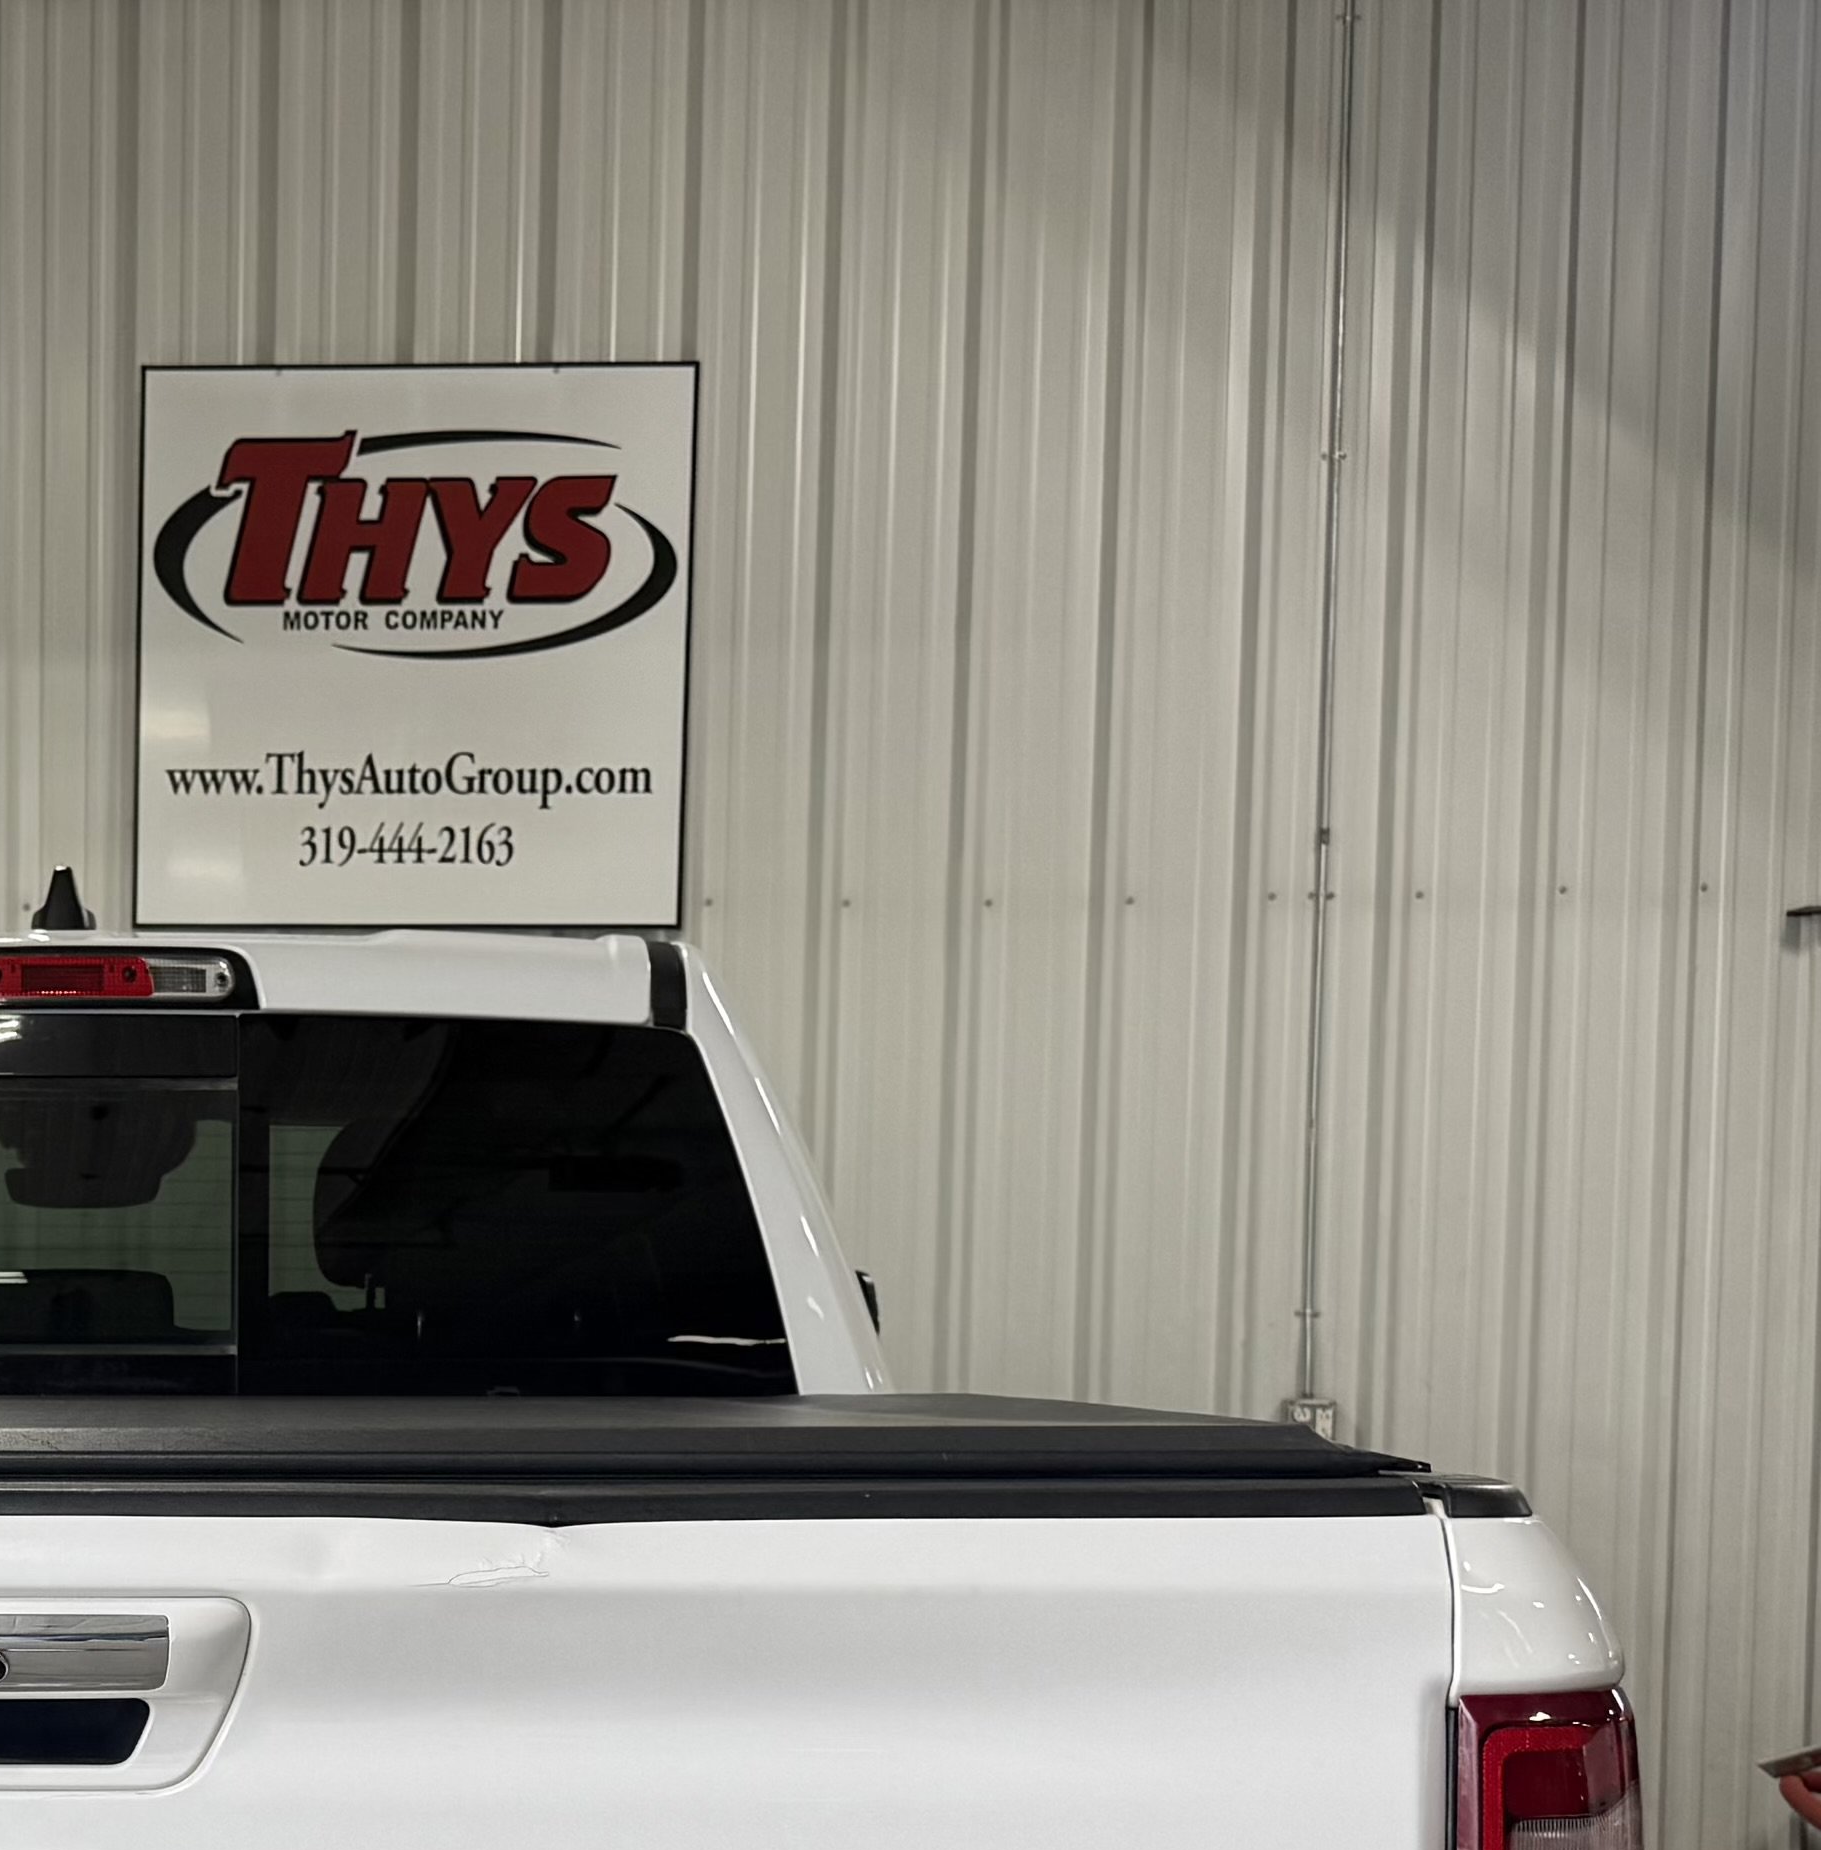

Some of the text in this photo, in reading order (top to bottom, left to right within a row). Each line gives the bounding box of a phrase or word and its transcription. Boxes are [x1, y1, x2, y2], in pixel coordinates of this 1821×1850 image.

[216, 429, 617, 606] THYS
[282, 609, 505, 631] MOTOR COMPANY
[166, 750, 653, 809] www.ThysAutoGroup.com
[298, 823, 515, 867] 319-444-2163
